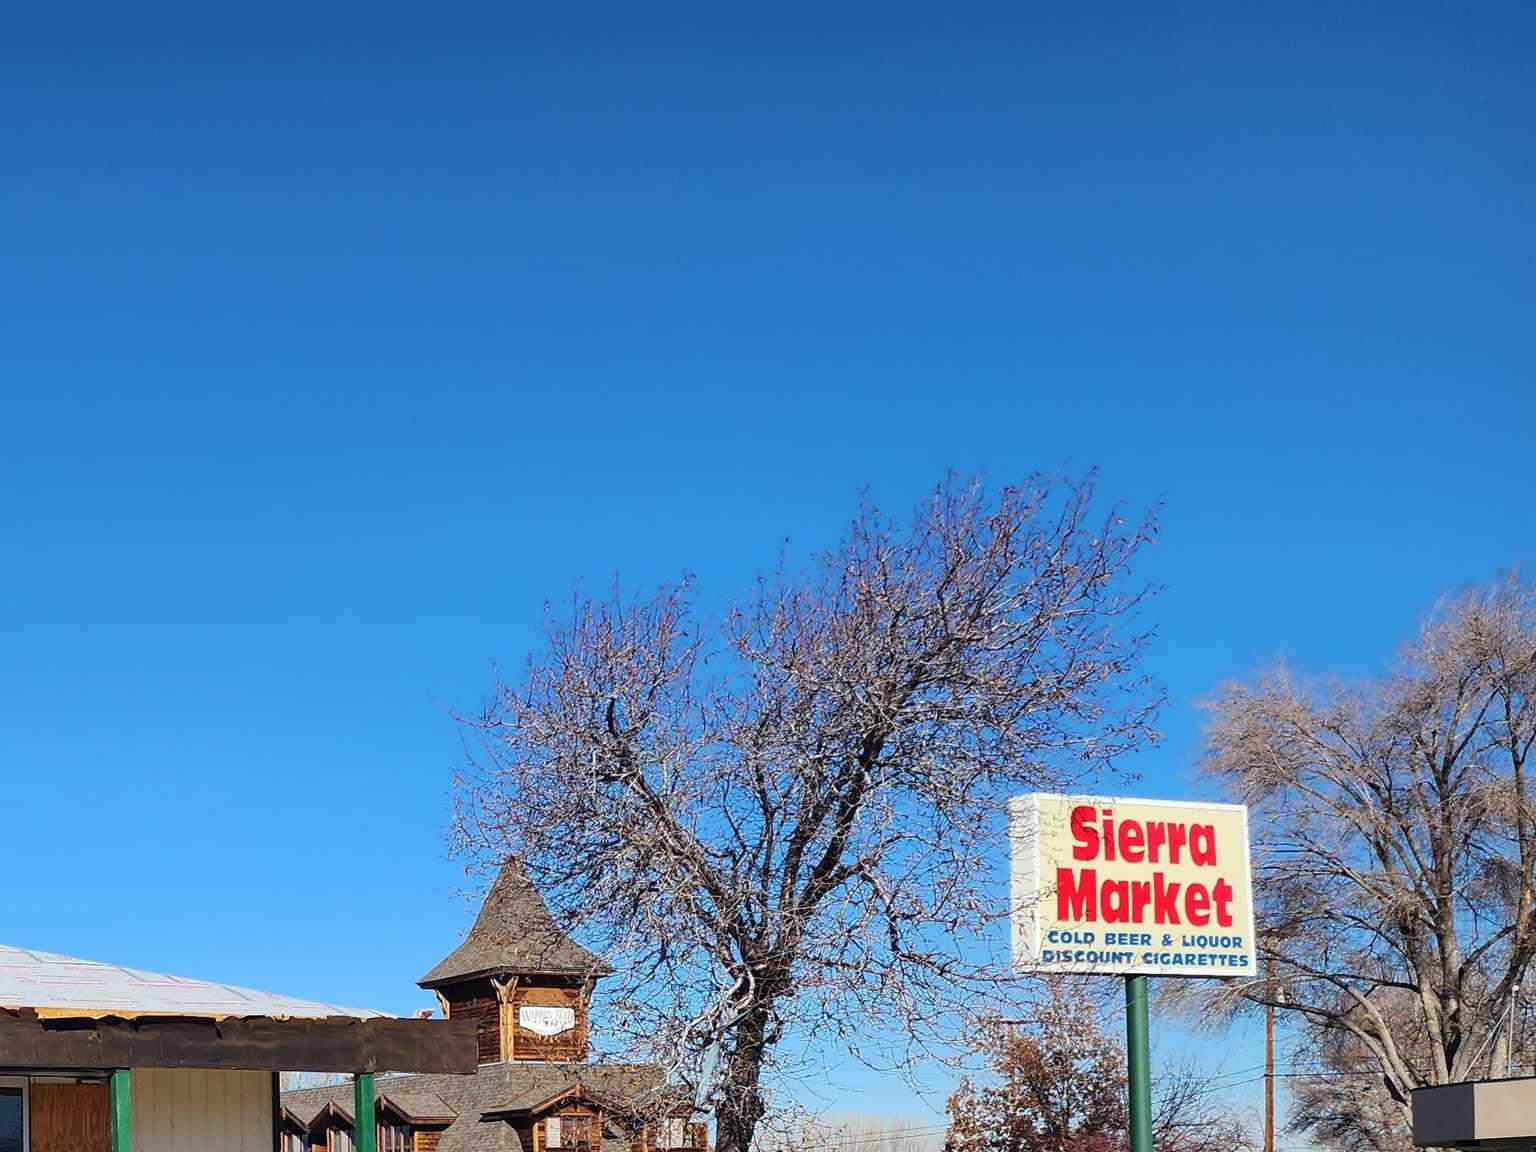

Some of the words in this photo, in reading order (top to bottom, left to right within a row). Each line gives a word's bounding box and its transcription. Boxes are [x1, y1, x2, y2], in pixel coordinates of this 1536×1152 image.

[1070, 805, 1217, 867] Sierra
[1056, 867, 1233, 928] Market
[1041, 949, 1134, 965] DISCOUNT
[1142, 951, 1249, 967] CIGARETTES
[1047, 930, 1095, 945] COLD
[1104, 932, 1152, 946] BEER
[1161, 933, 1173, 946] &
[1182, 935, 1243, 949] LIQUOR
